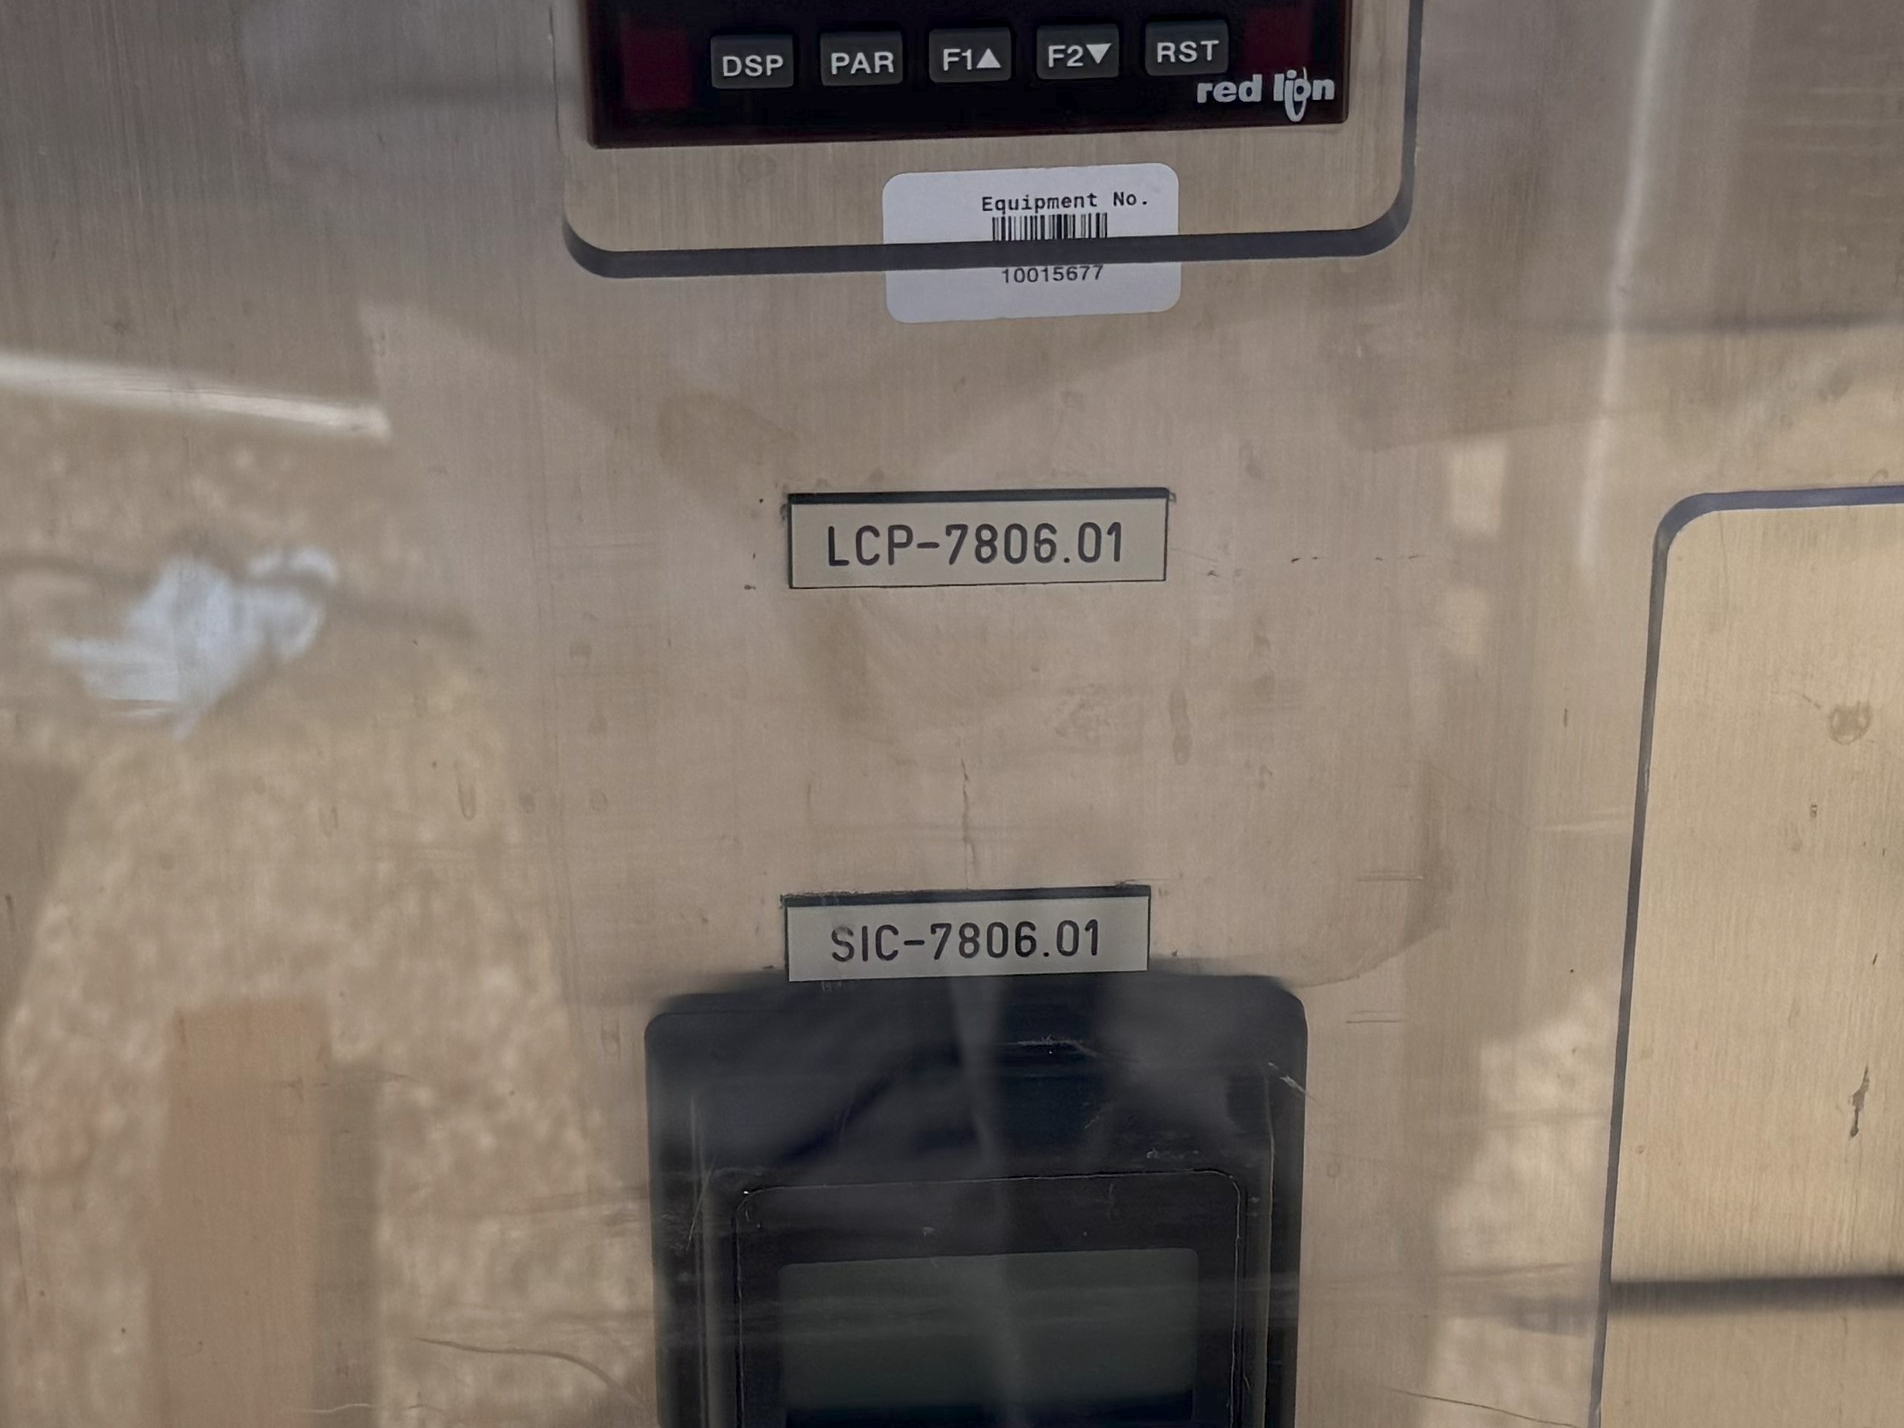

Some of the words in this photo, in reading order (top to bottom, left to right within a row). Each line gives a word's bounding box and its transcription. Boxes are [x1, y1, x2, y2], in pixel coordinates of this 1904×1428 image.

[829, 50, 896, 77] PAR
[942, 47, 974, 72] F1
[1047, 44, 1084, 69] F2
[1156, 39, 1219, 65] RST
[721, 52, 785, 79] DSP
[1197, 74, 1263, 103] red
[982, 192, 1098, 215] Equipment
[1113, 191, 1149, 208] No.
[1001, 265, 1104, 284] 10015677
[828, 522, 1123, 566] LCP-7806.01
[831, 919, 1099, 963] SIC-7806.01
